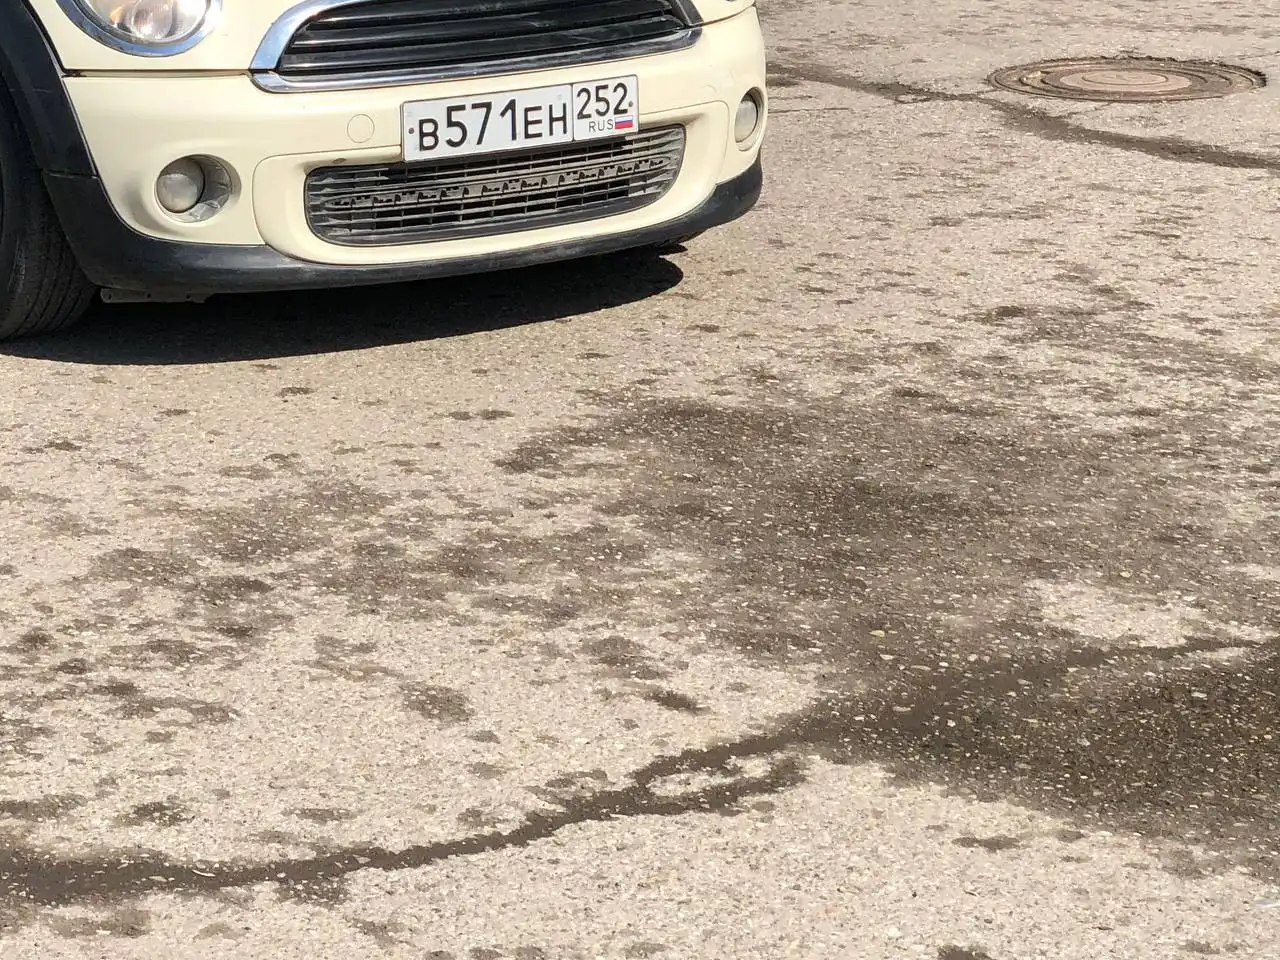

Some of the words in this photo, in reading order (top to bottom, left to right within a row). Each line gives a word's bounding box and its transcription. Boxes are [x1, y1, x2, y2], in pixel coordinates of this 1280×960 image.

[418, 98, 568, 152] В571ЕН
[577, 82, 628, 120] 252
[588, 118, 614, 133] RUS
